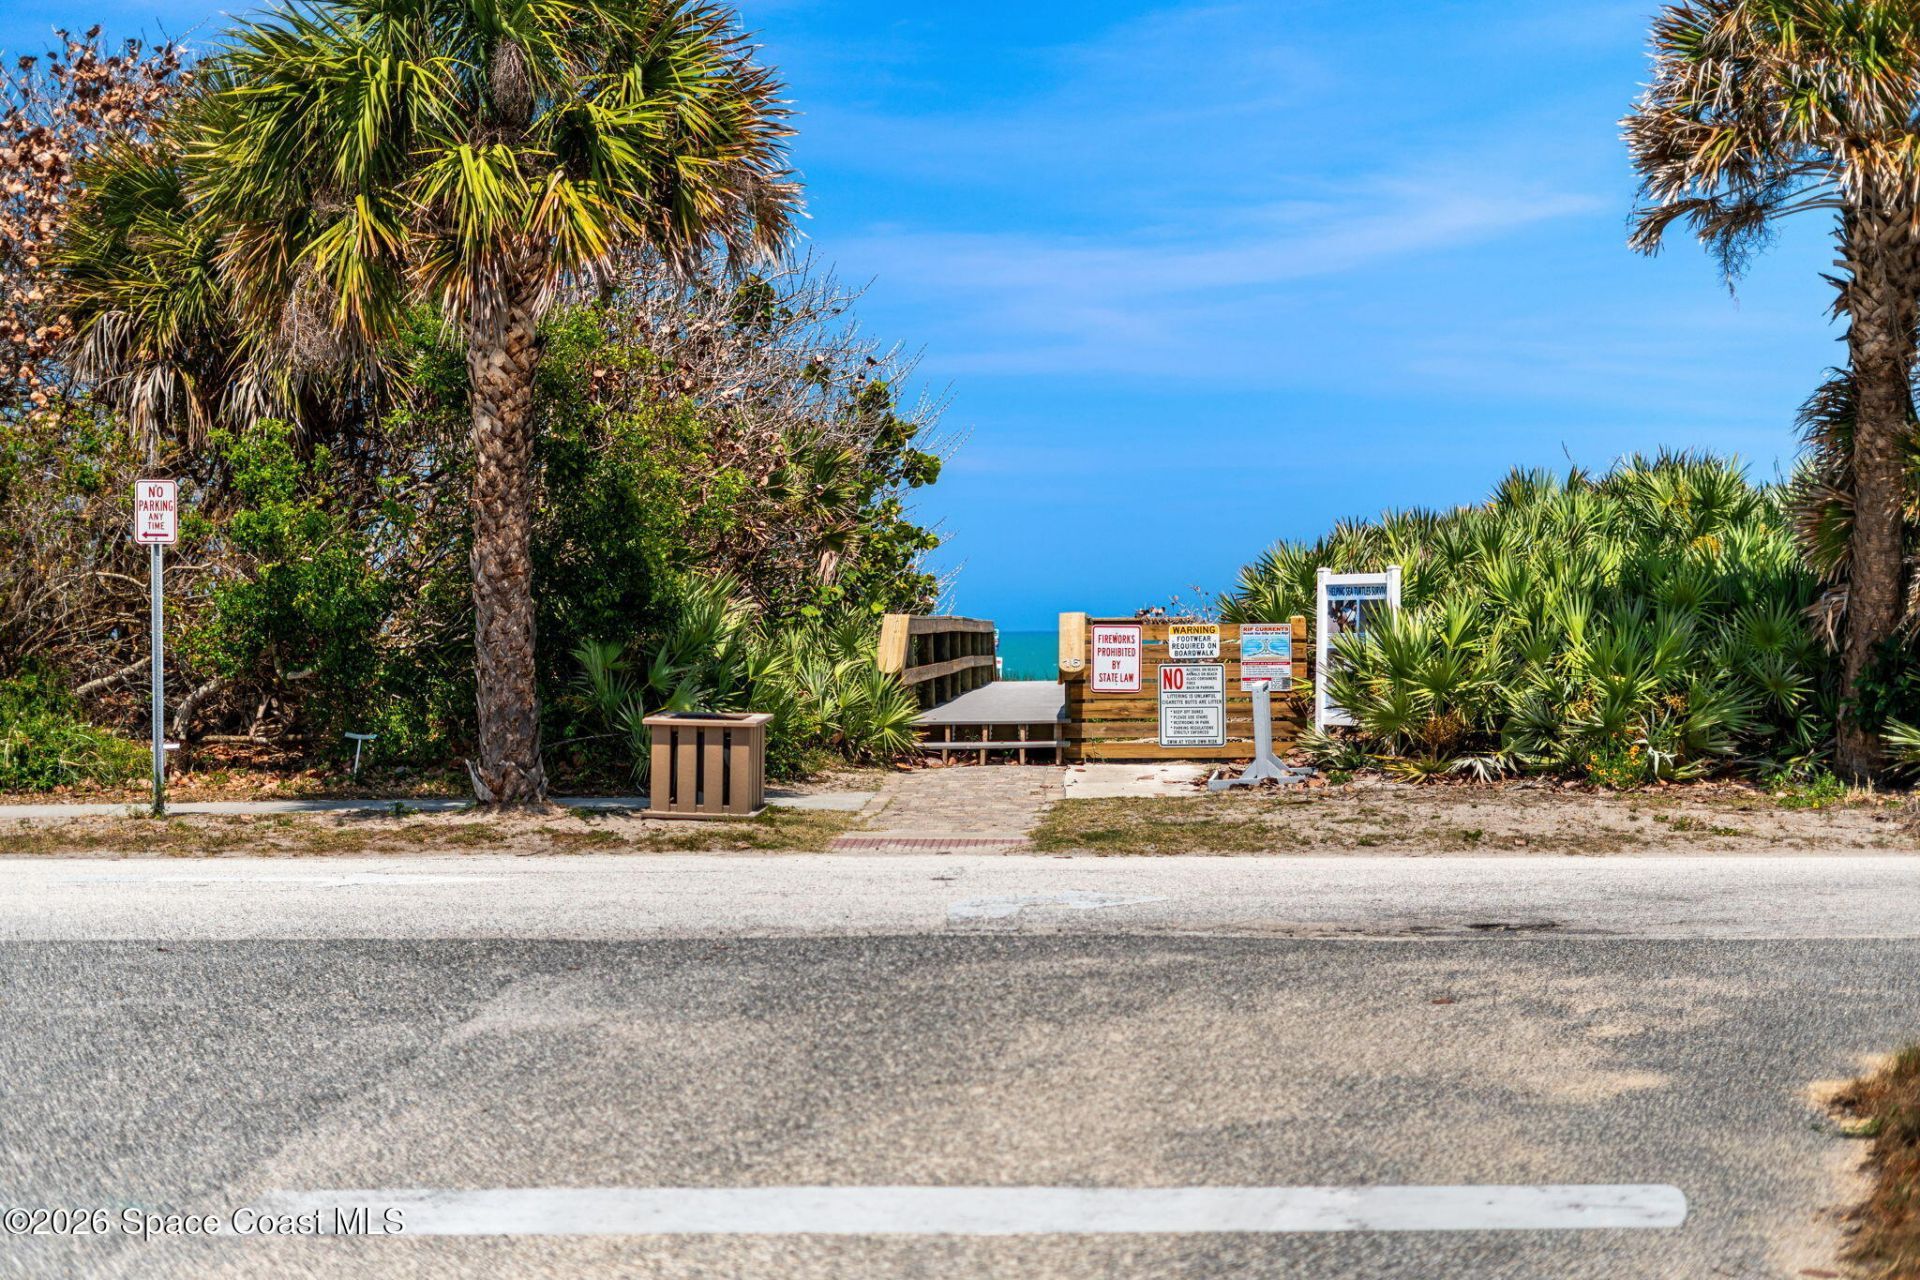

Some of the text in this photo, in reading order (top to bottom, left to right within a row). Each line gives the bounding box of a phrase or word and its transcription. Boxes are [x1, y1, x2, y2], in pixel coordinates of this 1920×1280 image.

[148, 486, 164, 498] NO
[138, 500, 174, 511] PARKING
[148, 512, 164, 520] ANY
[147, 521, 165, 530] TIME
[1345, 586, 1353, 596] SEA
[1354, 586, 1371, 596] TURTLES
[1371, 586, 1387, 595] SURVIV
[1172, 626, 1216, 634] WARNING
[1097, 634, 1136, 645] FIREWORKS
[1171, 642, 1217, 650] REQUIRED ON
[1097, 647, 1136, 657] PROHIBITED
[1111, 660, 1121, 670] BY
[1098, 672, 1135, 683] STATE LAW
[1163, 667, 1184, 690] NO
